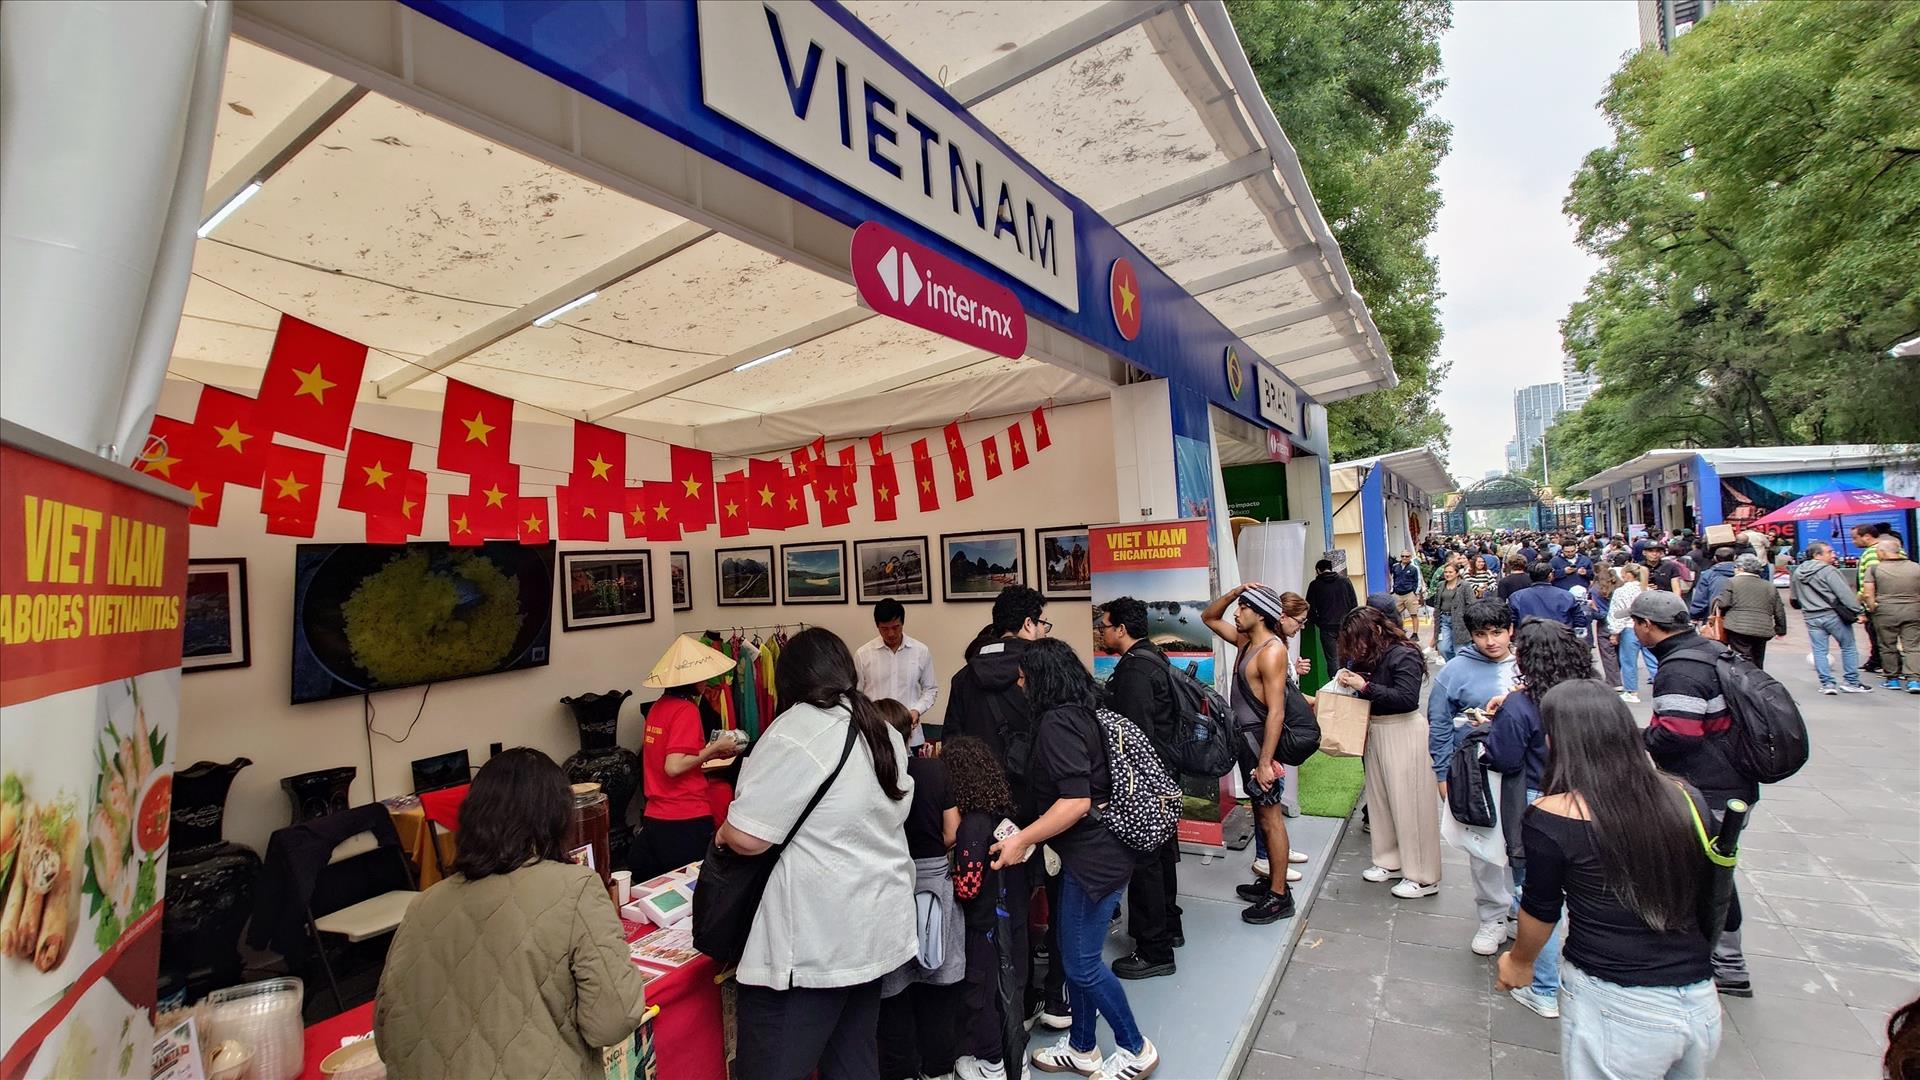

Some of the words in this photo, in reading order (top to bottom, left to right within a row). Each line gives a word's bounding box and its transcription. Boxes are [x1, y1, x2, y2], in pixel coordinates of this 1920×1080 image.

[763, 4, 1058, 277] VIETNAM
[926, 270, 1014, 340] inter.mx
[1264, 377, 1295, 423] BRASIL
[25, 495, 103, 584] VIET
[107, 515, 166, 588] NAM
[1106, 531, 1142, 550] VIET
[1146, 527, 1187, 547] NAM
[1113, 546, 1182, 561] ENCANTADOR
[88, 594, 180, 636] VIETNAMITAS
